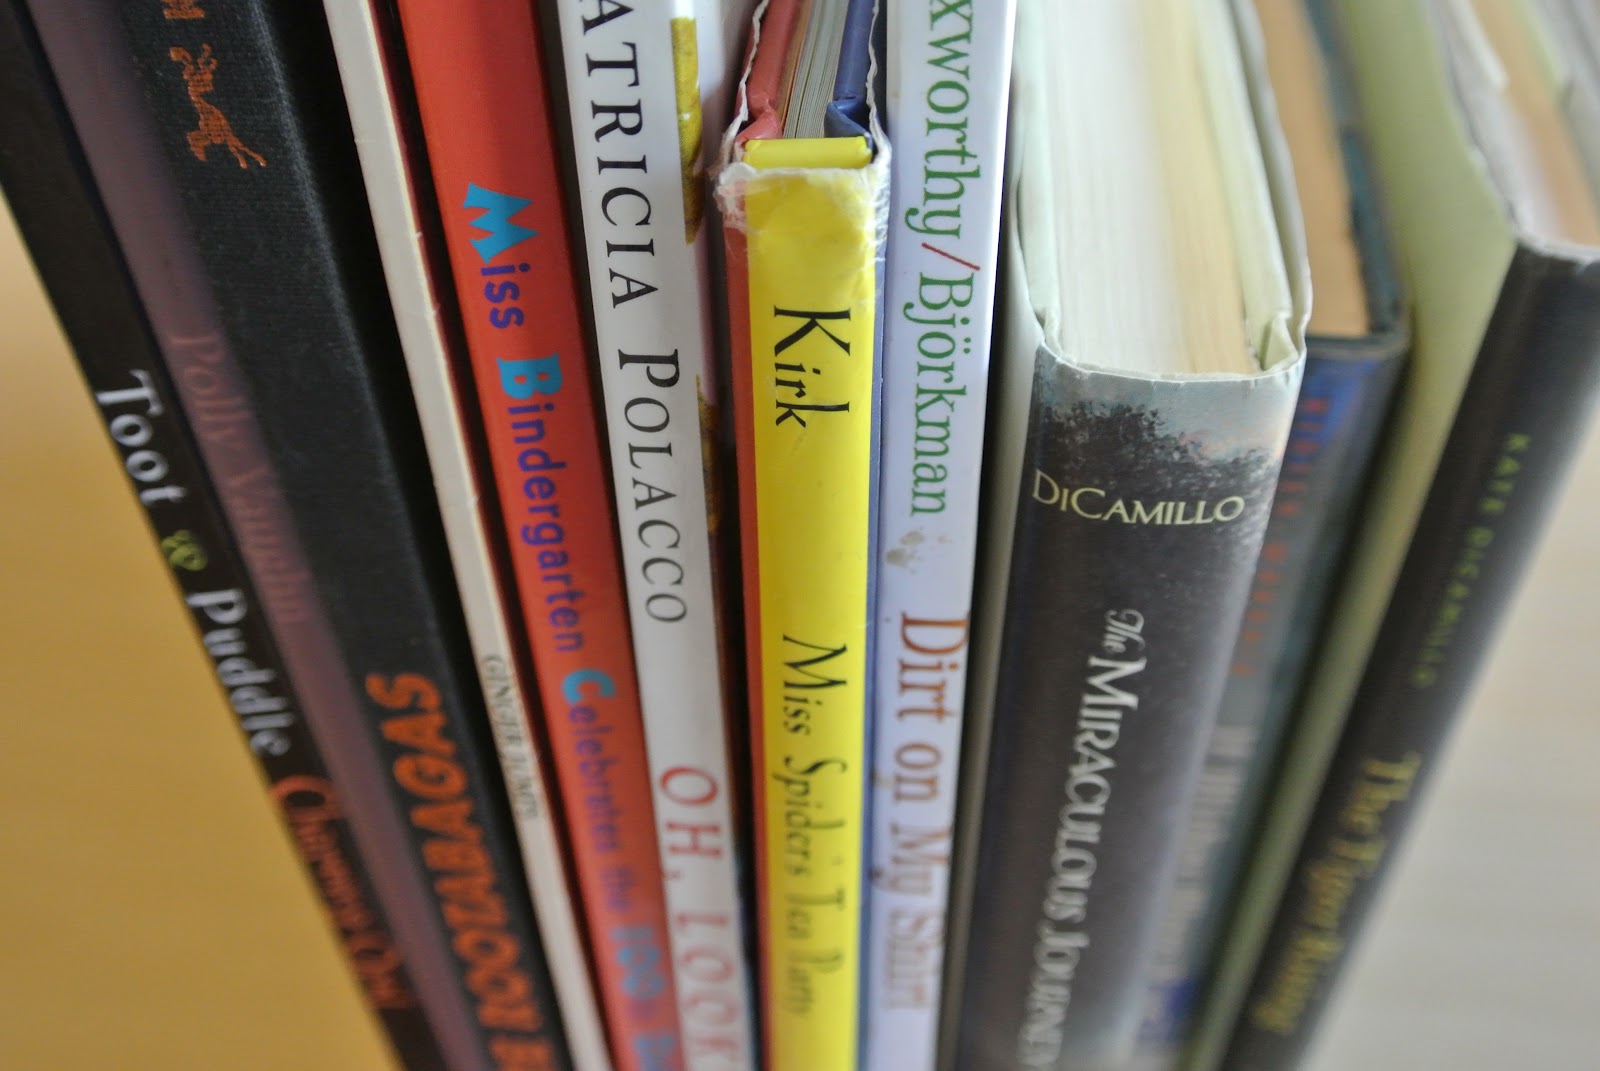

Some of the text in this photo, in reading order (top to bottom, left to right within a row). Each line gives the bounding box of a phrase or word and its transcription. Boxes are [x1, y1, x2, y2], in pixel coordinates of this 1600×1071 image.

[462, 182, 540, 330] Miss
[773, 305, 851, 428] Kirk
[496, 352, 586, 652] Bindergarten
[617, 348, 688, 624] POLACCO
[95, 368, 188, 506] Toot
[187, 588, 293, 757] Puddle
[1102, 608, 1146, 654] The
[782, 634, 847, 736] Miss
[897, 611, 969, 722] Dirt
[561, 667, 623, 853] Celebrates
[893, 743, 943, 804] on
[1044, 655, 1147, 923] MIRACULOUS
